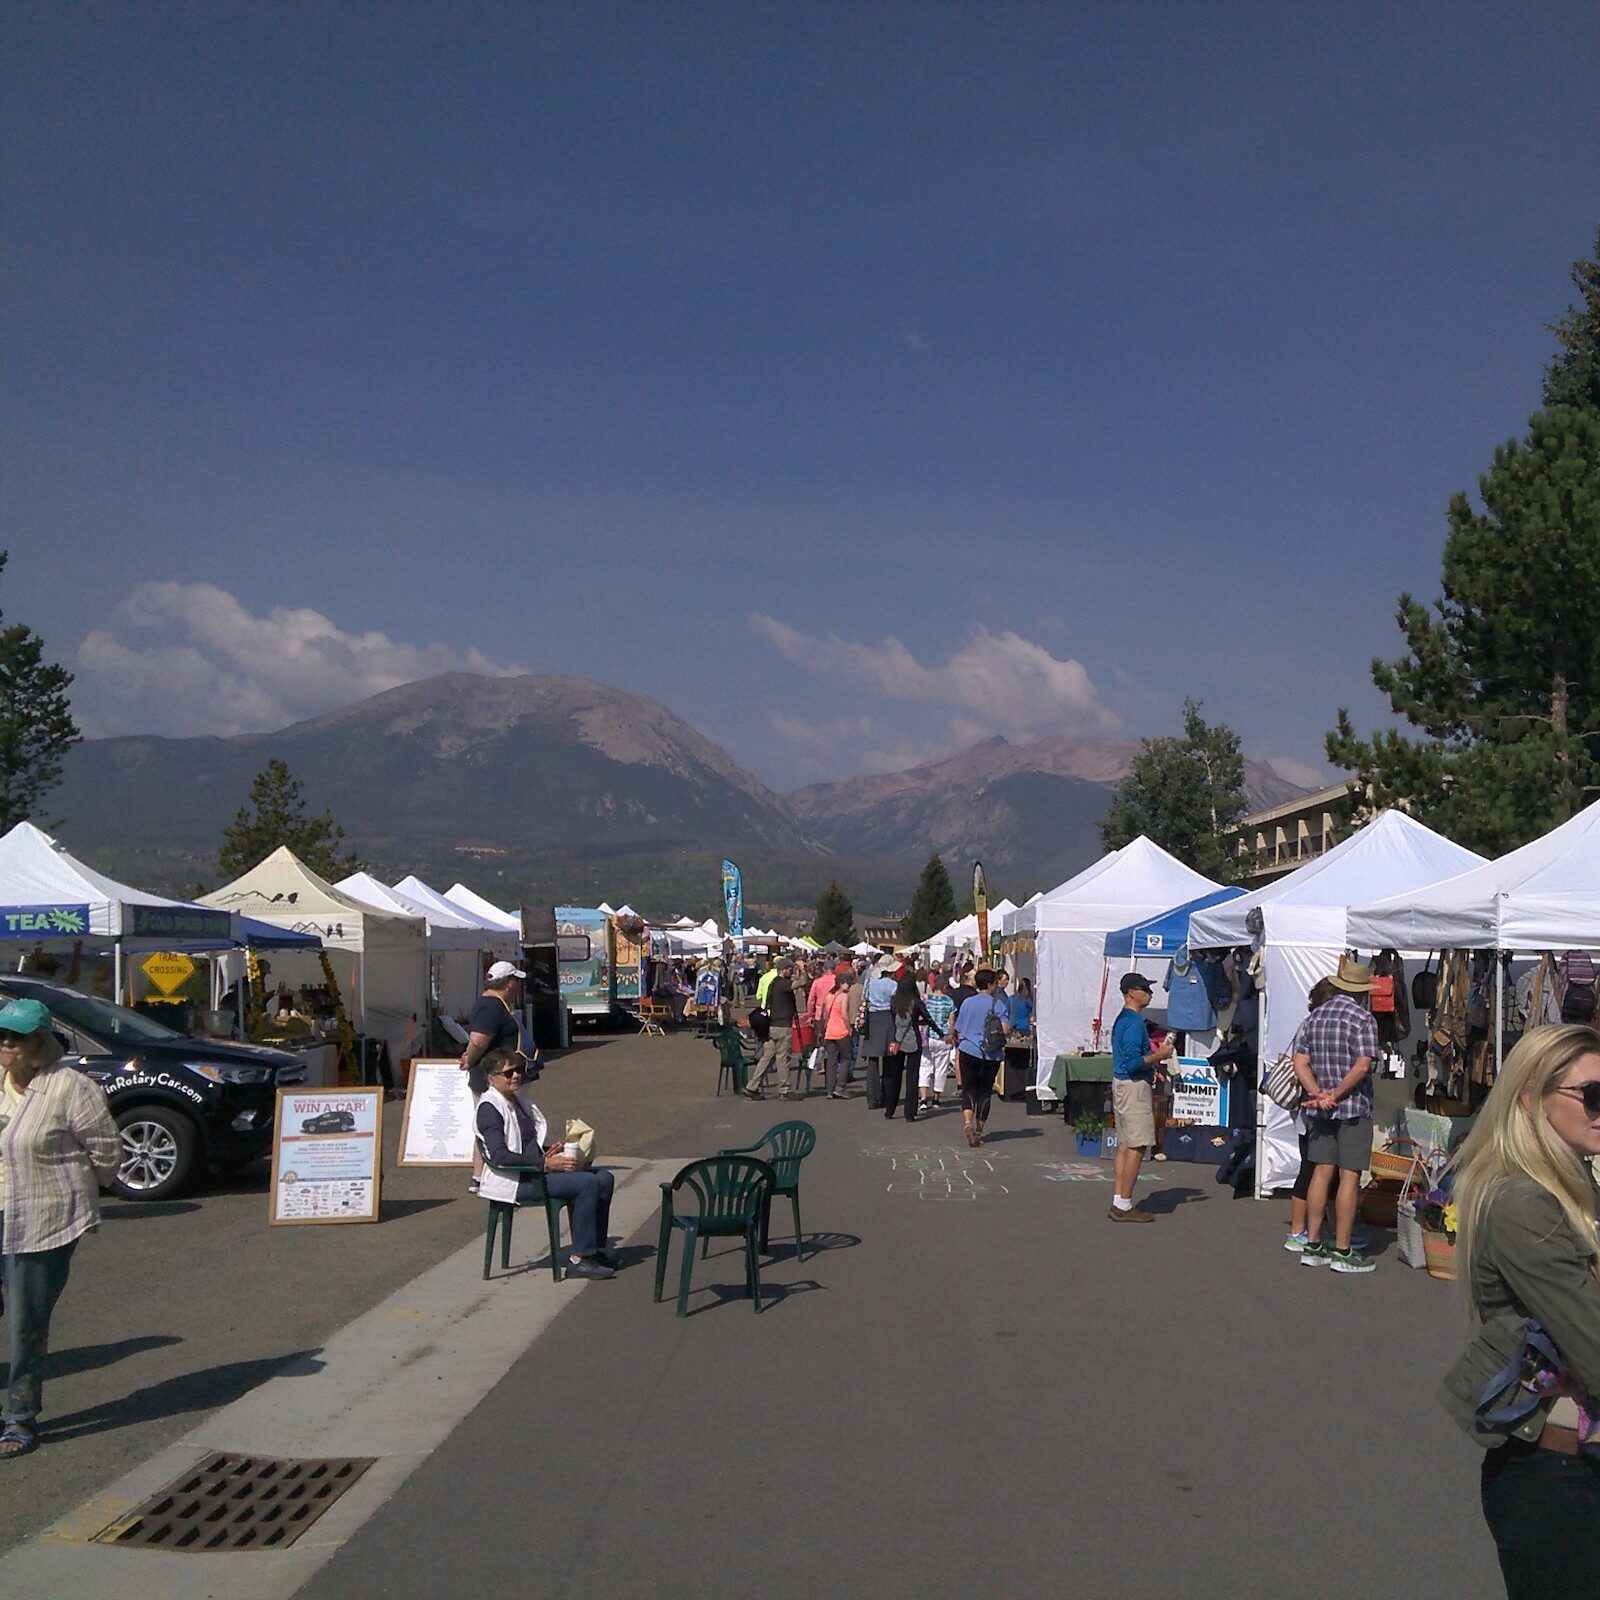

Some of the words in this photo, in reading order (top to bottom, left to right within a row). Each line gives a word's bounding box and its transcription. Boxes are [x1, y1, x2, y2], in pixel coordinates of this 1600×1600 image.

[5, 913, 51, 931] TEA
[149, 965, 188, 975] CROSSING
[559, 974, 584, 985] ADO
[101, 1072, 203, 1103] inRotaryCar.com
[1175, 1083, 1218, 1096] SUMMIT
[294, 1103, 320, 1113] WIN
[323, 1103, 331, 1112] A
[1107, 1136, 1118, 1147] DI
